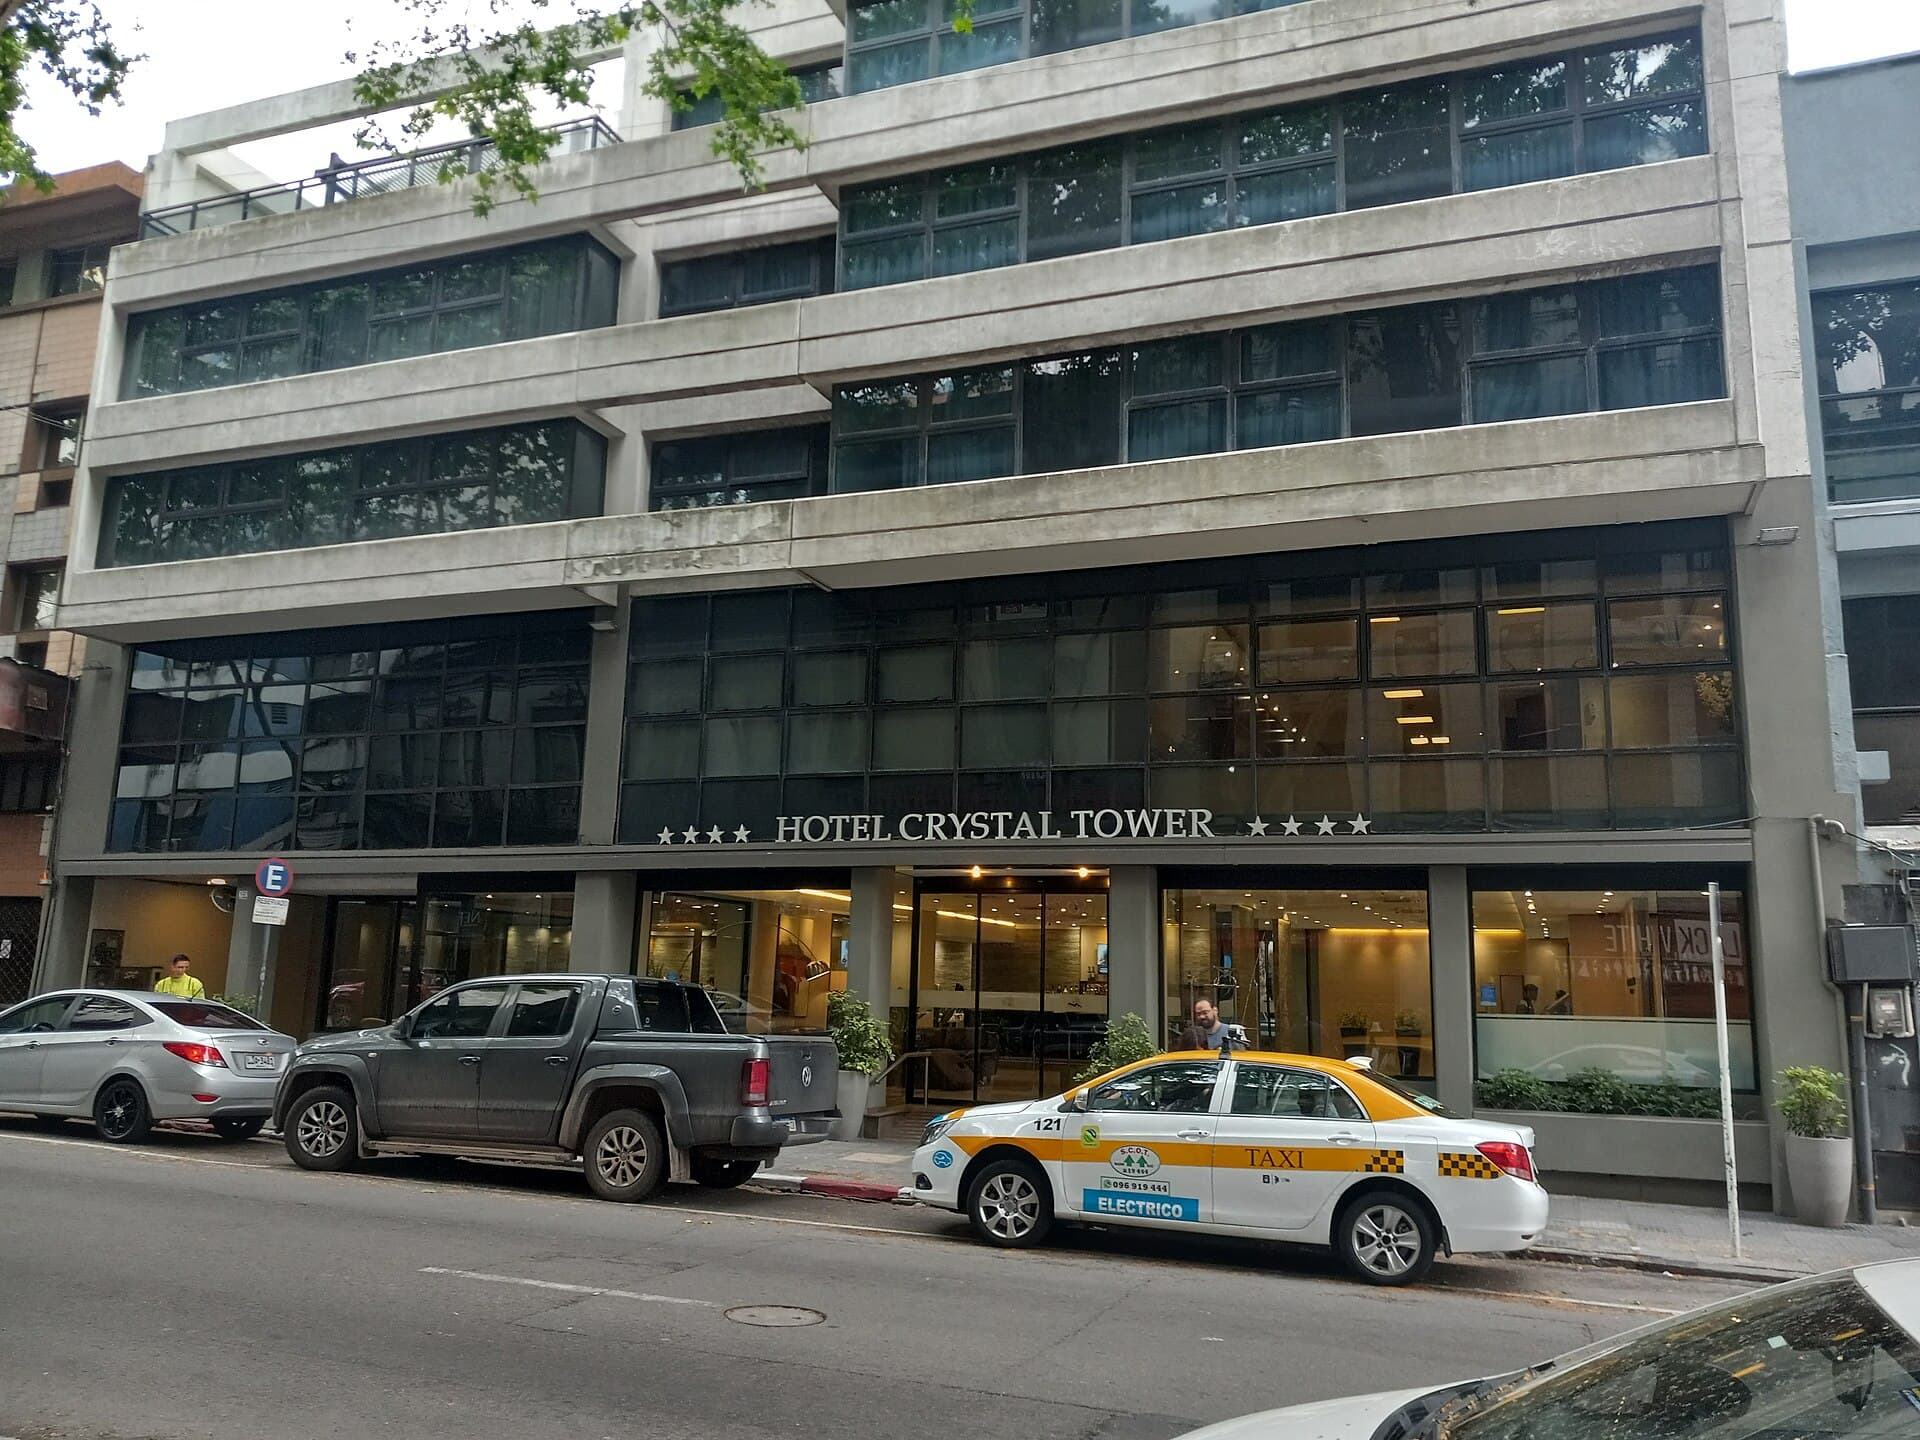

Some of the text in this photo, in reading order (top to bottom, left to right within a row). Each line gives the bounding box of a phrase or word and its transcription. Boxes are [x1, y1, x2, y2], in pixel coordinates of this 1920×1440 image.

[775, 808, 1215, 843] HOTEL CRYSTAL TOWER
[266, 864, 284, 890] E
[1033, 1117, 1061, 1131] 121
[1245, 1148, 1304, 1169] TAXI
[1112, 1181, 1168, 1192] 096 919 444
[1098, 1197, 1183, 1218] ELECTRICO
